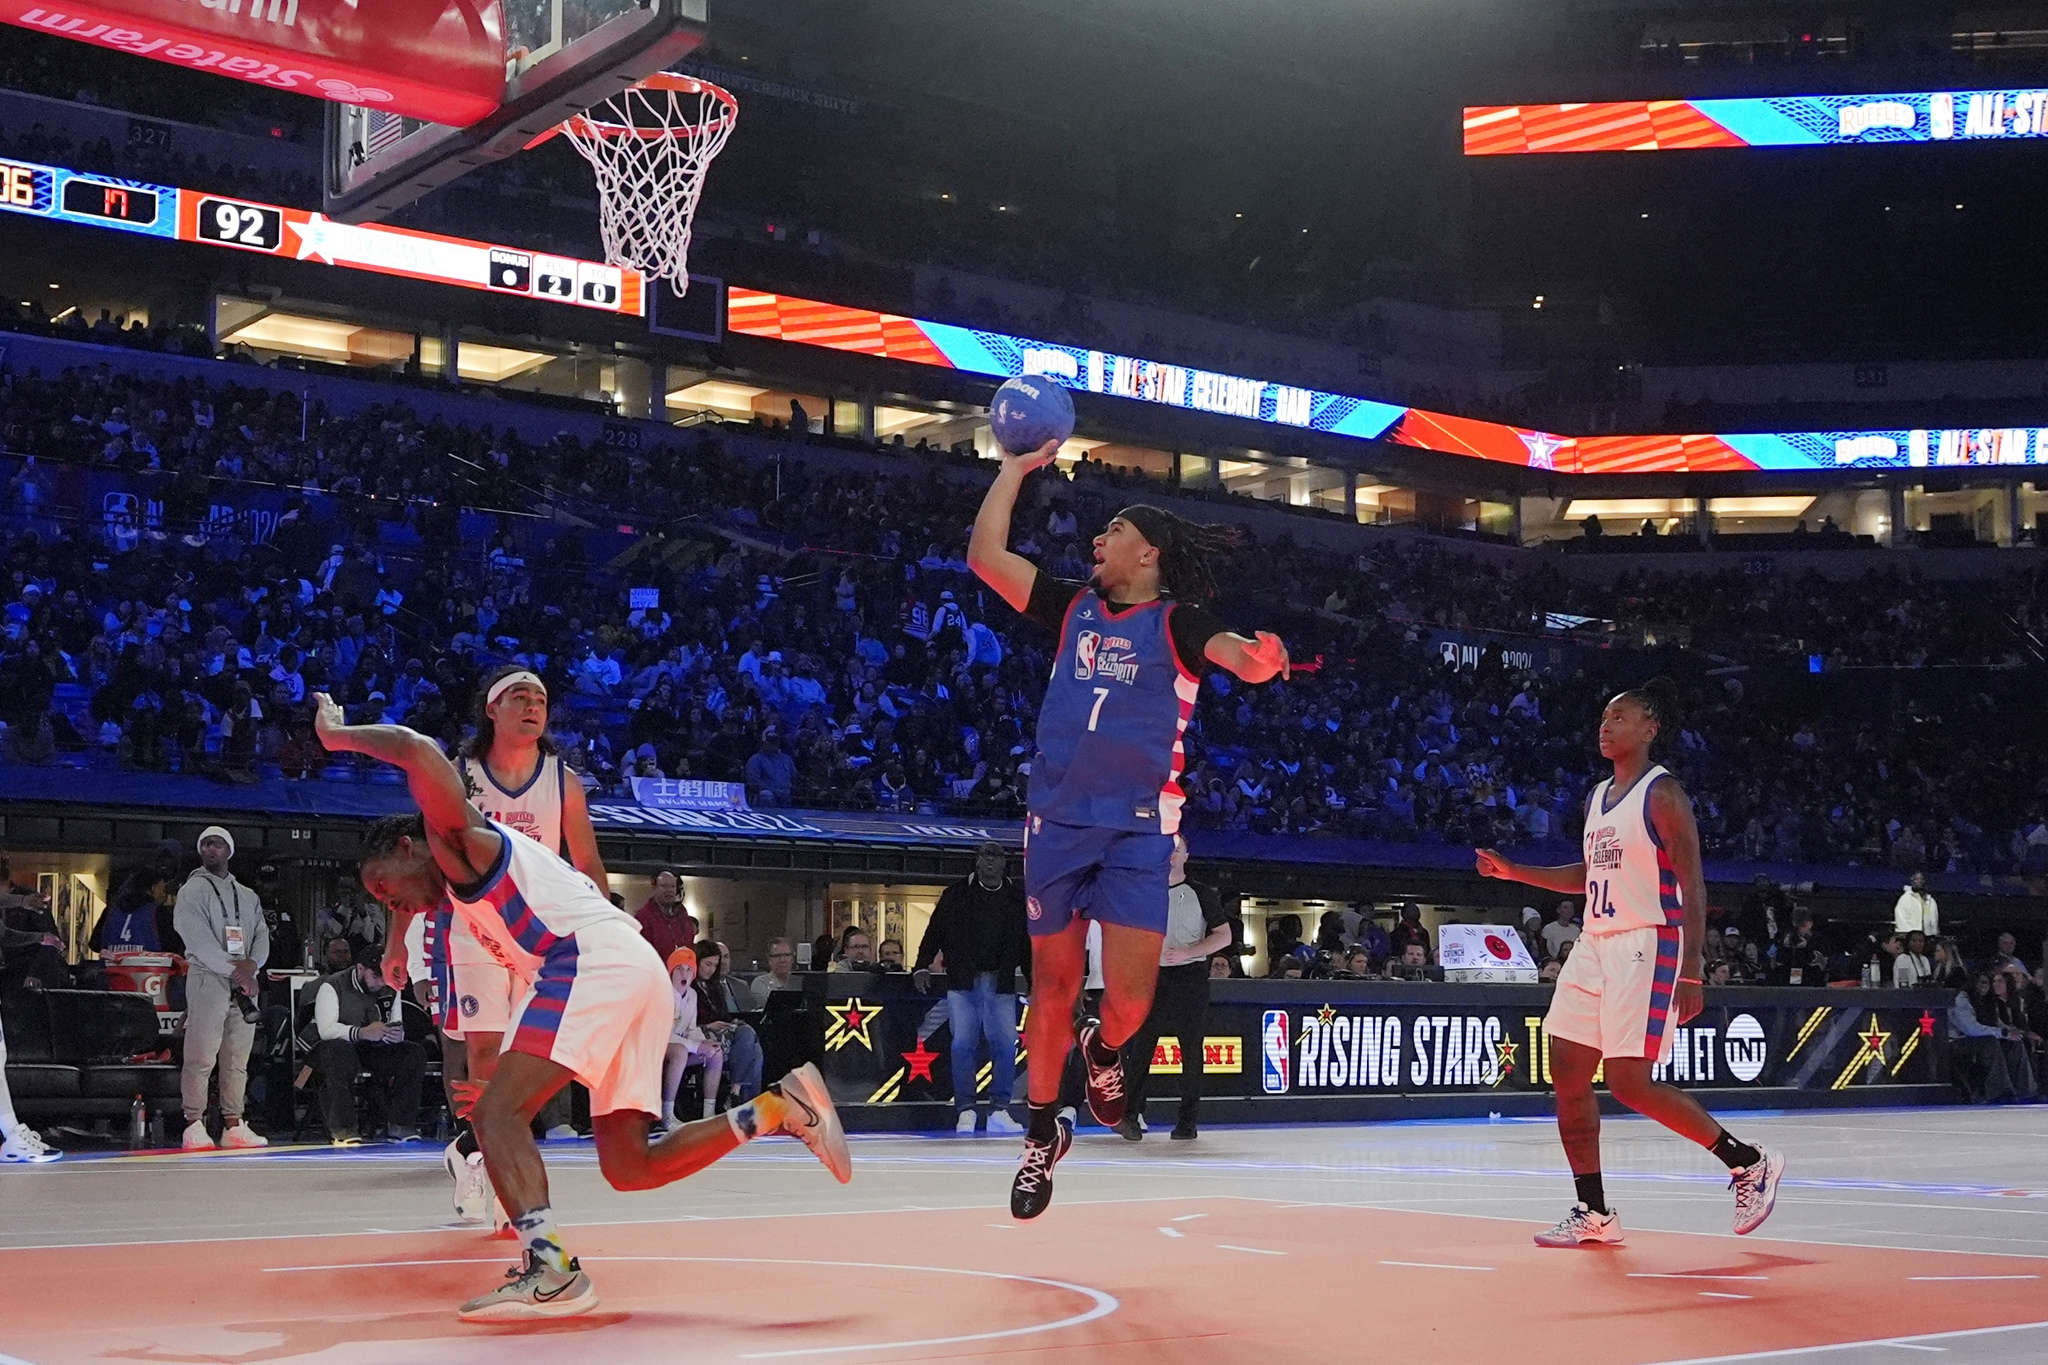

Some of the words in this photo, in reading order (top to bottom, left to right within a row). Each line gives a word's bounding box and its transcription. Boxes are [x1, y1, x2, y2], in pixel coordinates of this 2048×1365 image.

[1842, 104, 1912, 132] RUFFLES
[131, 127, 168, 145] 327
[214, 203, 265, 246] 92
[491, 250, 530, 268] BONUS
[548, 275, 562, 295] 2
[593, 283, 606, 302] 0
[1025, 350, 1077, 376] RUFFLES
[605, 429, 638, 449] 228
[946, 613, 960, 627] 24
[1087, 687, 1109, 732] 7
[701, 810, 824, 833] 2024
[901, 824, 992, 838] INDY
[1589, 879, 1616, 918] 24
[119, 913, 133, 942] 4
[144, 975, 161, 996] G
[1298, 1015, 1402, 1088] RISING
[1410, 1015, 1501, 1088] STARS
